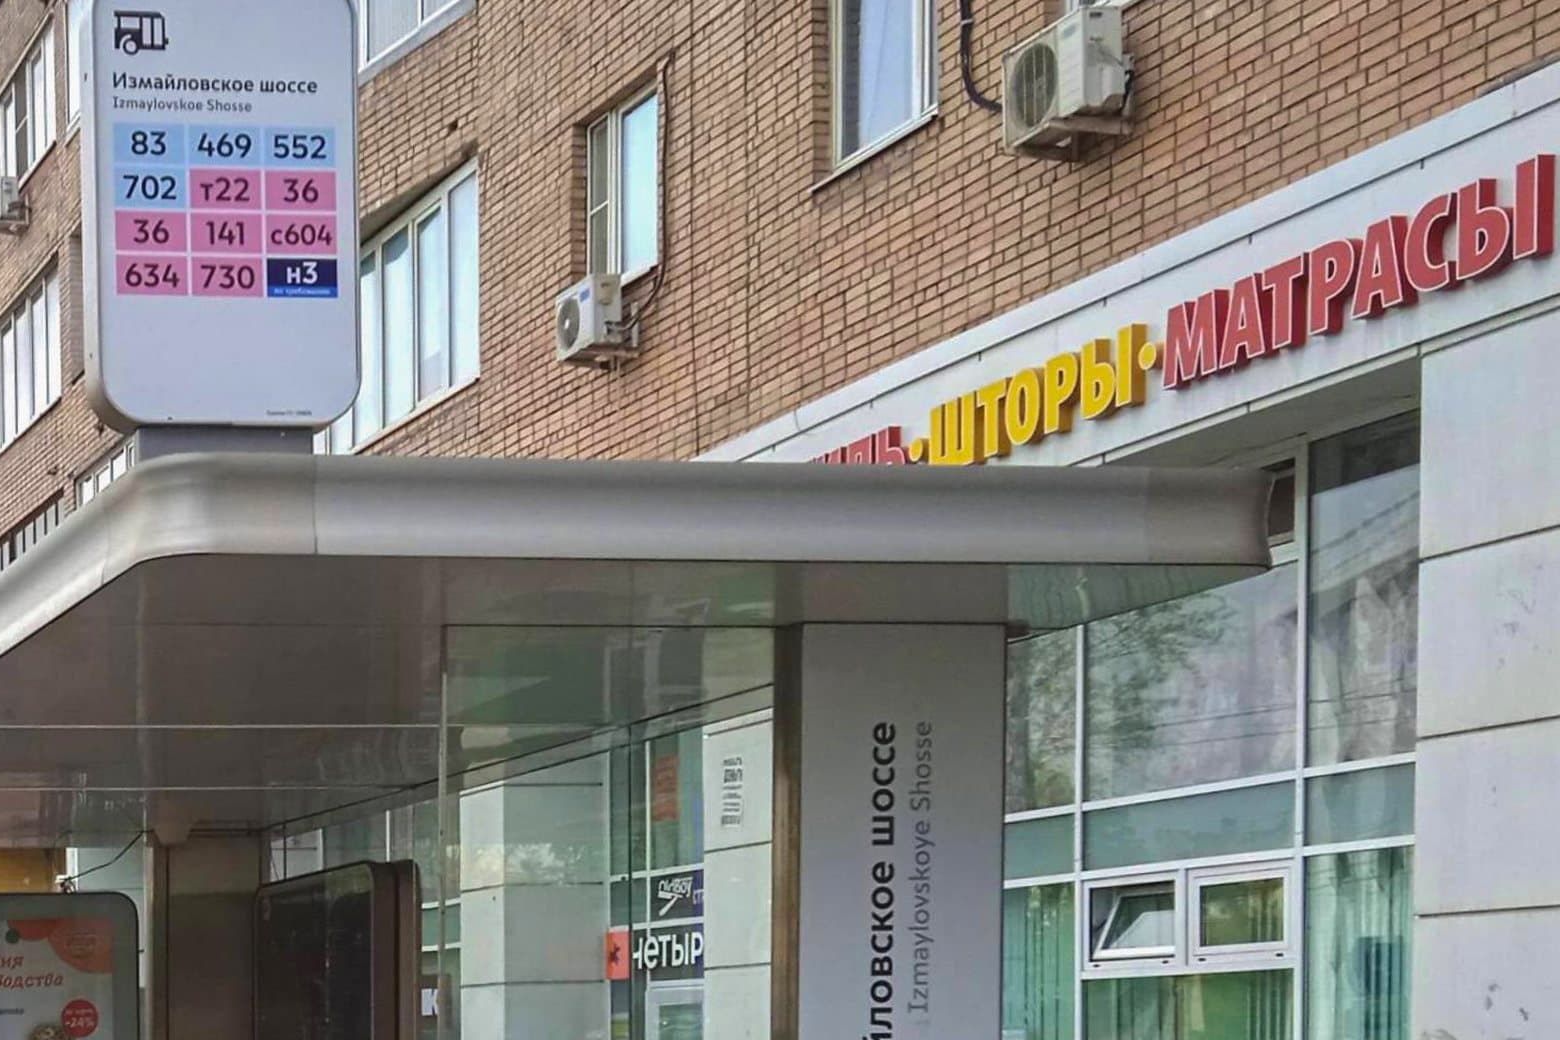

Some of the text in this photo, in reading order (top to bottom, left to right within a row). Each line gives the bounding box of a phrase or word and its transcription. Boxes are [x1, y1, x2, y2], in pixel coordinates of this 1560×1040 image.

[113, 72, 318, 94] Измайловское шоссе
[112, 96, 252, 113] Izmaylovskoe Shosse
[131, 130, 328, 159] 83 469 552
[123, 174, 178, 201] 702
[283, 178, 320, 204] 36
[133, 219, 171, 245] 36
[205, 221, 246, 246] 141
[124, 262, 181, 289] 634
[200, 264, 256, 290] 730
[928, 322, 1148, 466] ШТОРЫ
[1162, 154, 1556, 391] МАТРАСЫ
[871, 722, 896, 847] шоссе
[907, 720, 936, 1014] Izmaylovskoye Shosse
